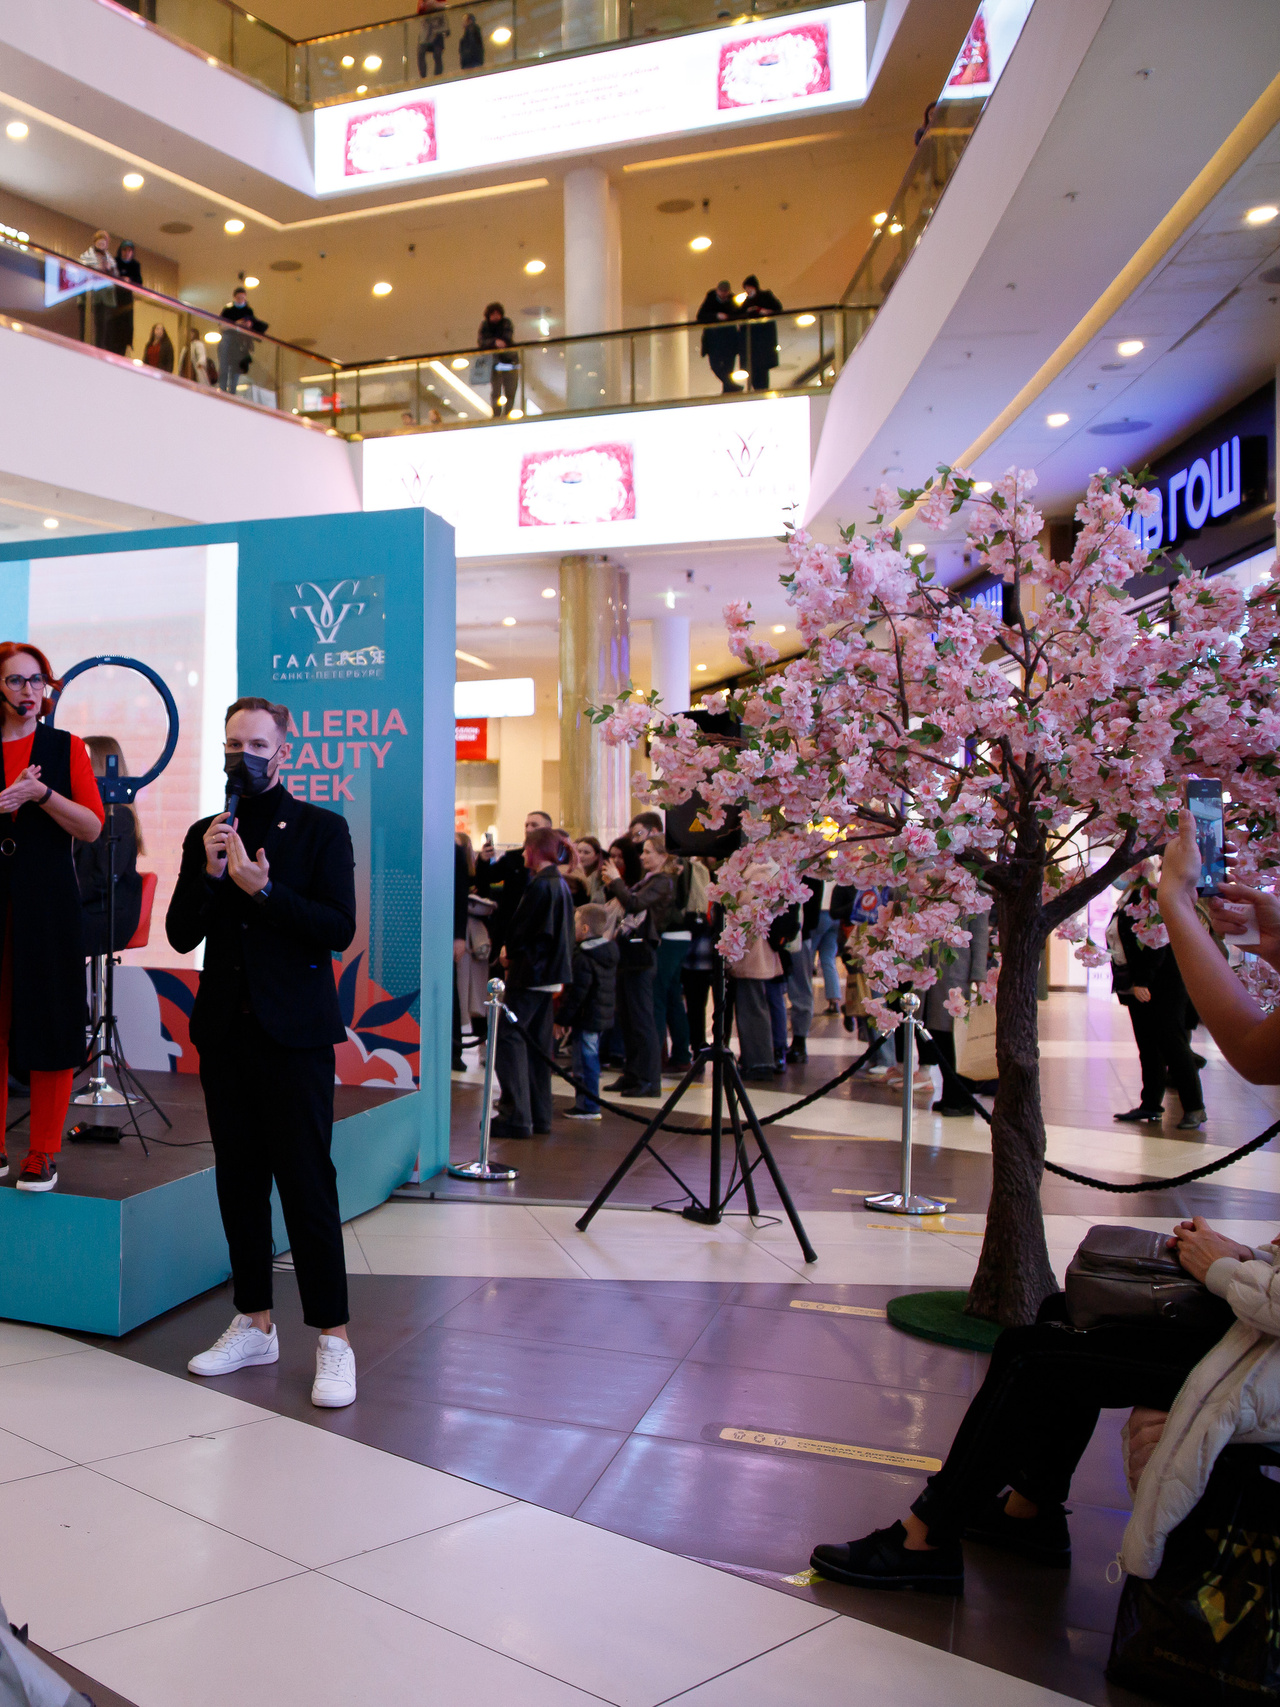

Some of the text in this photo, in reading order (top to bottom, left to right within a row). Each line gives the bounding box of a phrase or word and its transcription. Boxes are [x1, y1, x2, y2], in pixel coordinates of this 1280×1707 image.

[1168, 434, 1241, 542] ГОШ
[272, 669, 384, 681] САНКТ-ПЕТЕРБУРГ
[286, 708, 408, 738] ALERIA
[278, 741, 393, 770] EAUTY
[278, 774, 355, 802] EEK
